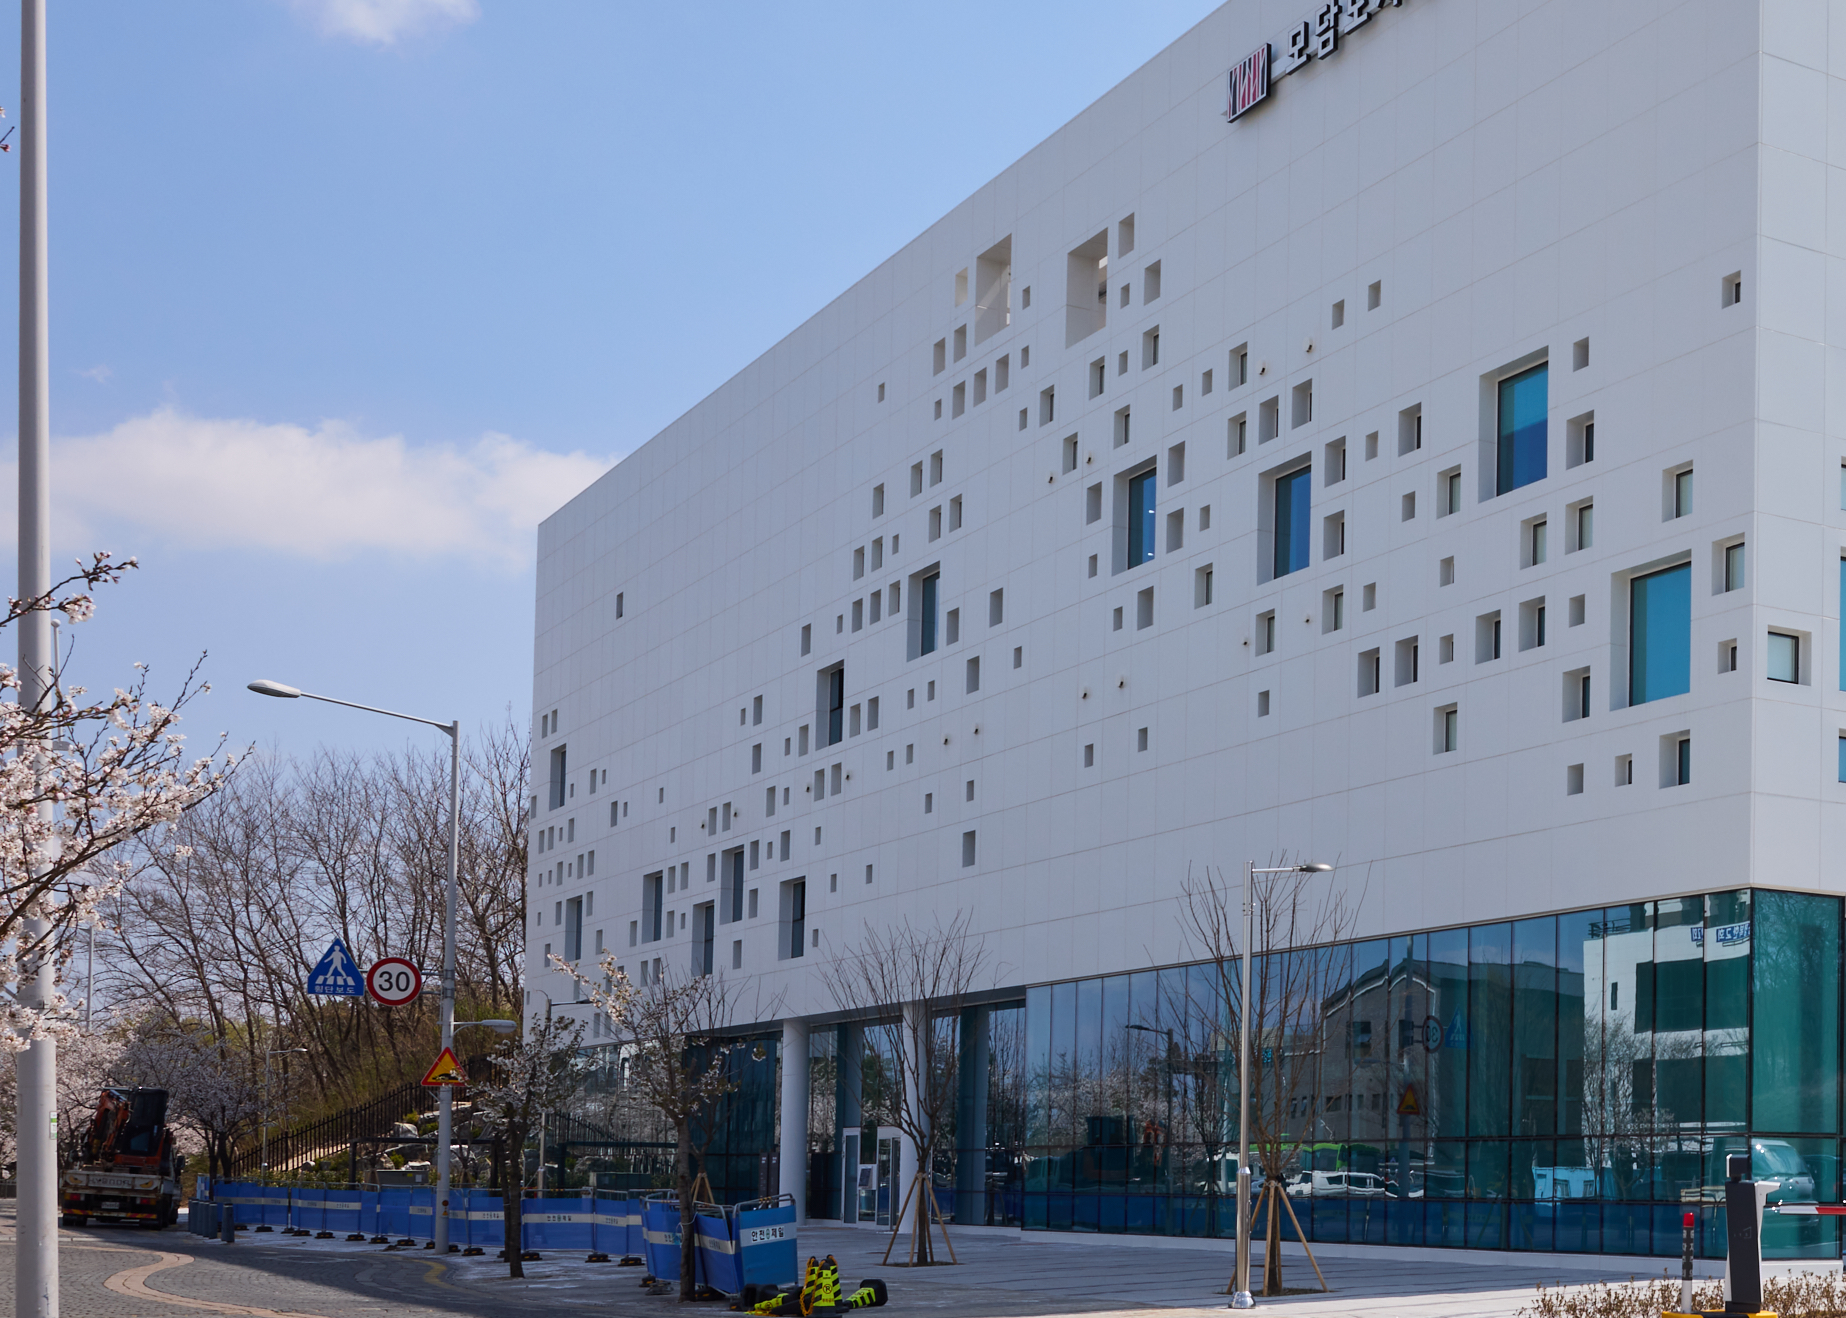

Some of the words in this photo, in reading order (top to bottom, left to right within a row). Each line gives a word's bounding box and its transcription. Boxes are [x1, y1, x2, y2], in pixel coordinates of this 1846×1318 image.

[314, 985, 356, 994] 횡단보도
[378, 971, 410, 992] 30
[751, 1230, 765, 1242] 안전
[771, 1226, 785, 1238] 제일
